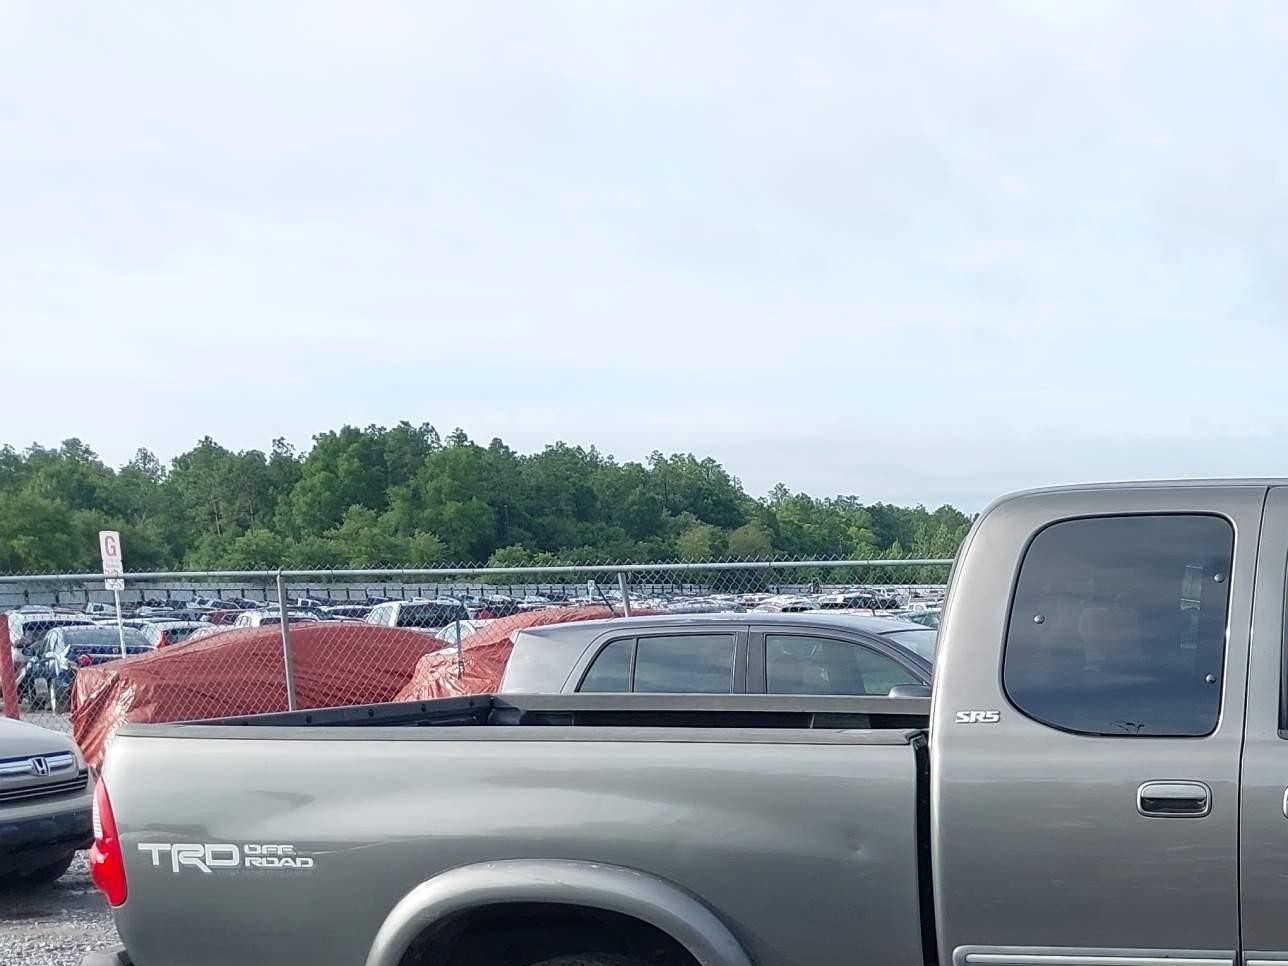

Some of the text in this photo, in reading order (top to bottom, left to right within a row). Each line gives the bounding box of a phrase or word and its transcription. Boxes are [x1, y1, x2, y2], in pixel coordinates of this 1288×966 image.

[104, 535, 117, 557] G
[955, 710, 1000, 723] SR5
[243, 844, 296, 855] OFF
[137, 842, 240, 873] TRD
[244, 857, 314, 868] ROAD
